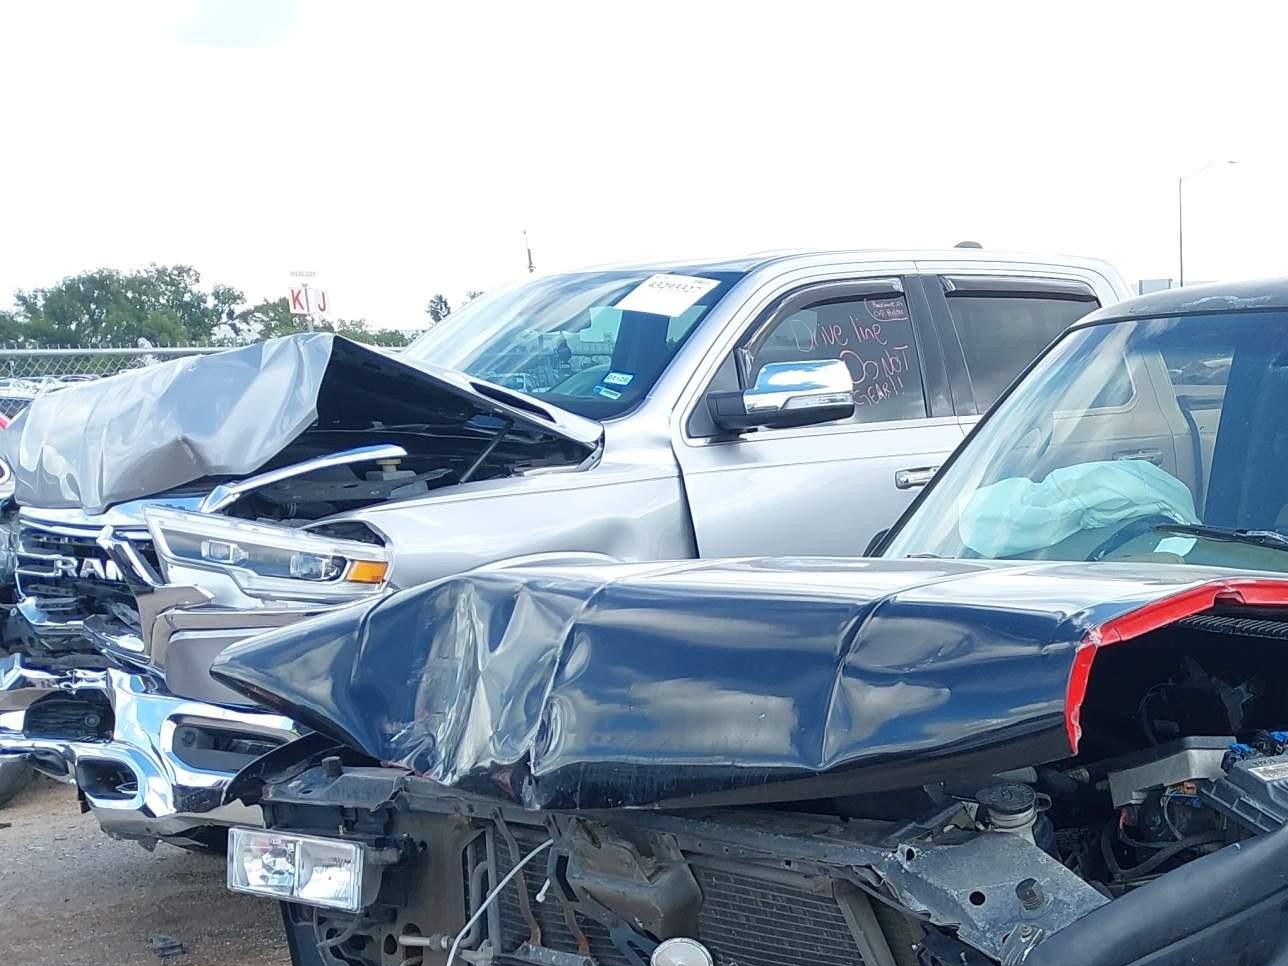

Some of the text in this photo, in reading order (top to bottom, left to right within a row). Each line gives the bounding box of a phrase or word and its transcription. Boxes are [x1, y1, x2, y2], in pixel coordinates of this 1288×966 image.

[291, 288, 305, 310] K
[317, 291, 326, 312] J
[849, 314, 888, 345] line
